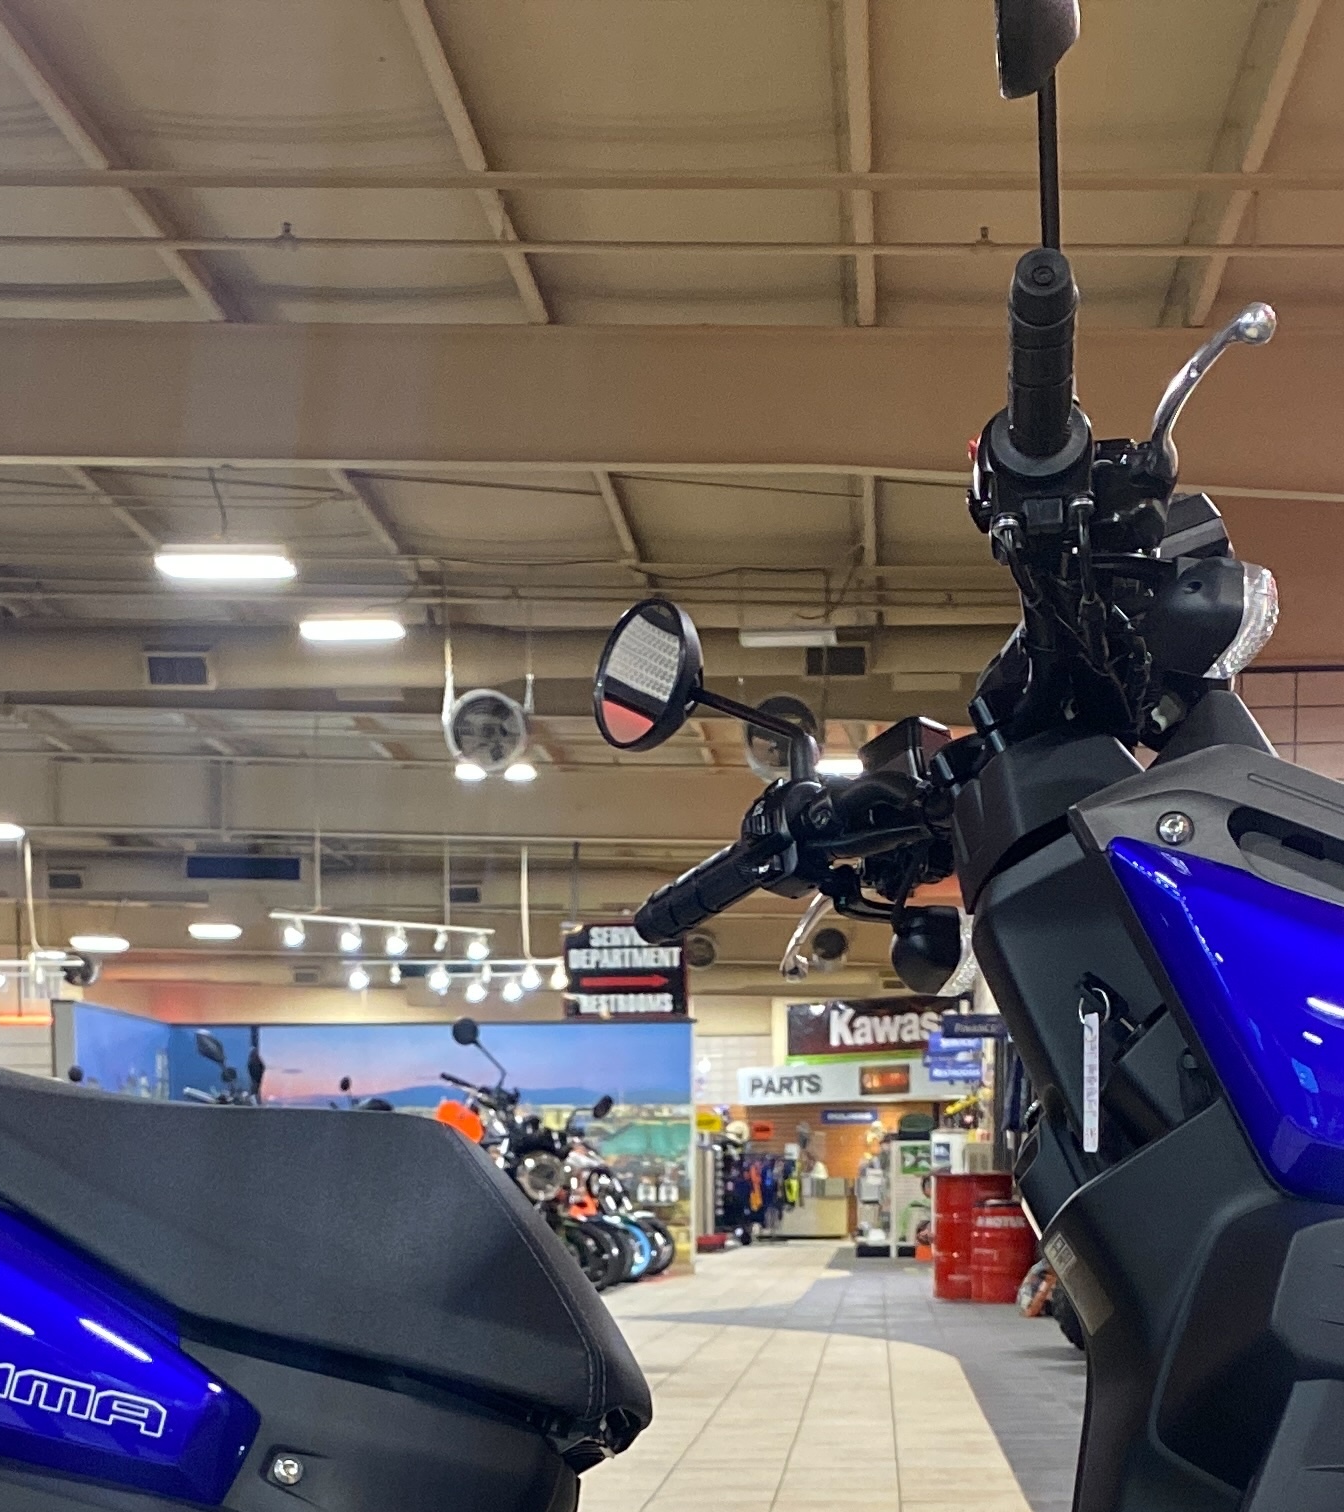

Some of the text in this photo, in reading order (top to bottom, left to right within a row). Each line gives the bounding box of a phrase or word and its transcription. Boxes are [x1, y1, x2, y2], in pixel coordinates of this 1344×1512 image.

[589, 926, 651, 947] SERVI
[568, 947, 682, 970] DEPARTMENT
[577, 993, 674, 1014] RESTROOMS
[829, 1006, 958, 1047] Kawas
[749, 1074, 822, 1097] PARTS
